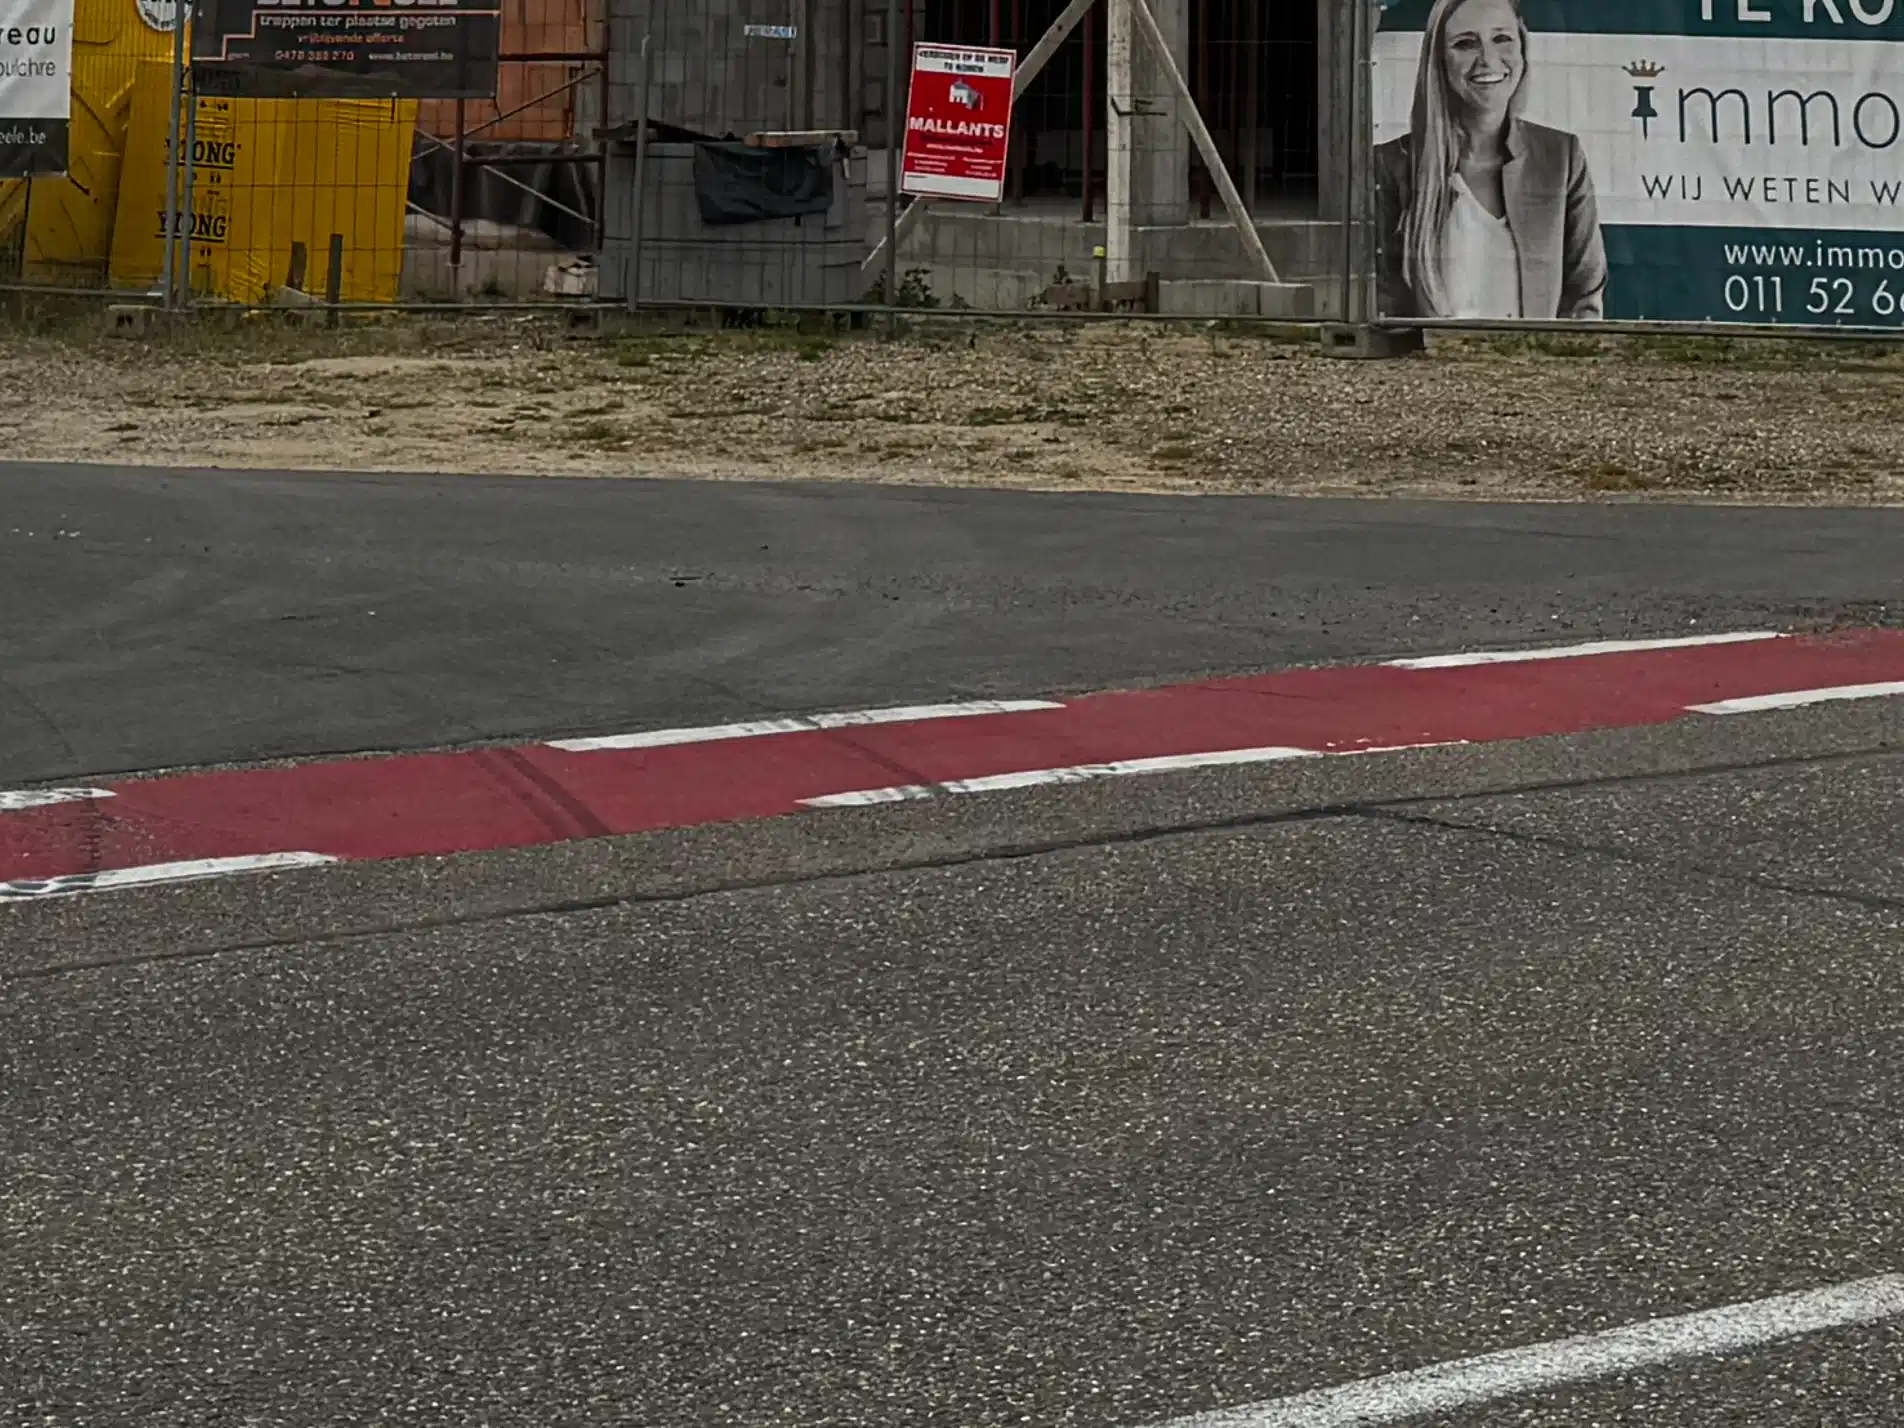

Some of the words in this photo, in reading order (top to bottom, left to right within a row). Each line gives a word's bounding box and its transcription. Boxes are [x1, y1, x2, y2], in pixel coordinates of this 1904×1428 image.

[909, 116, 1005, 139] MALLANTS
[1641, 174, 1702, 202] WIJ
[1722, 176, 1851, 205] WETEN
[1723, 274, 1784, 313] 011
[1805, 276, 1856, 315] 52
